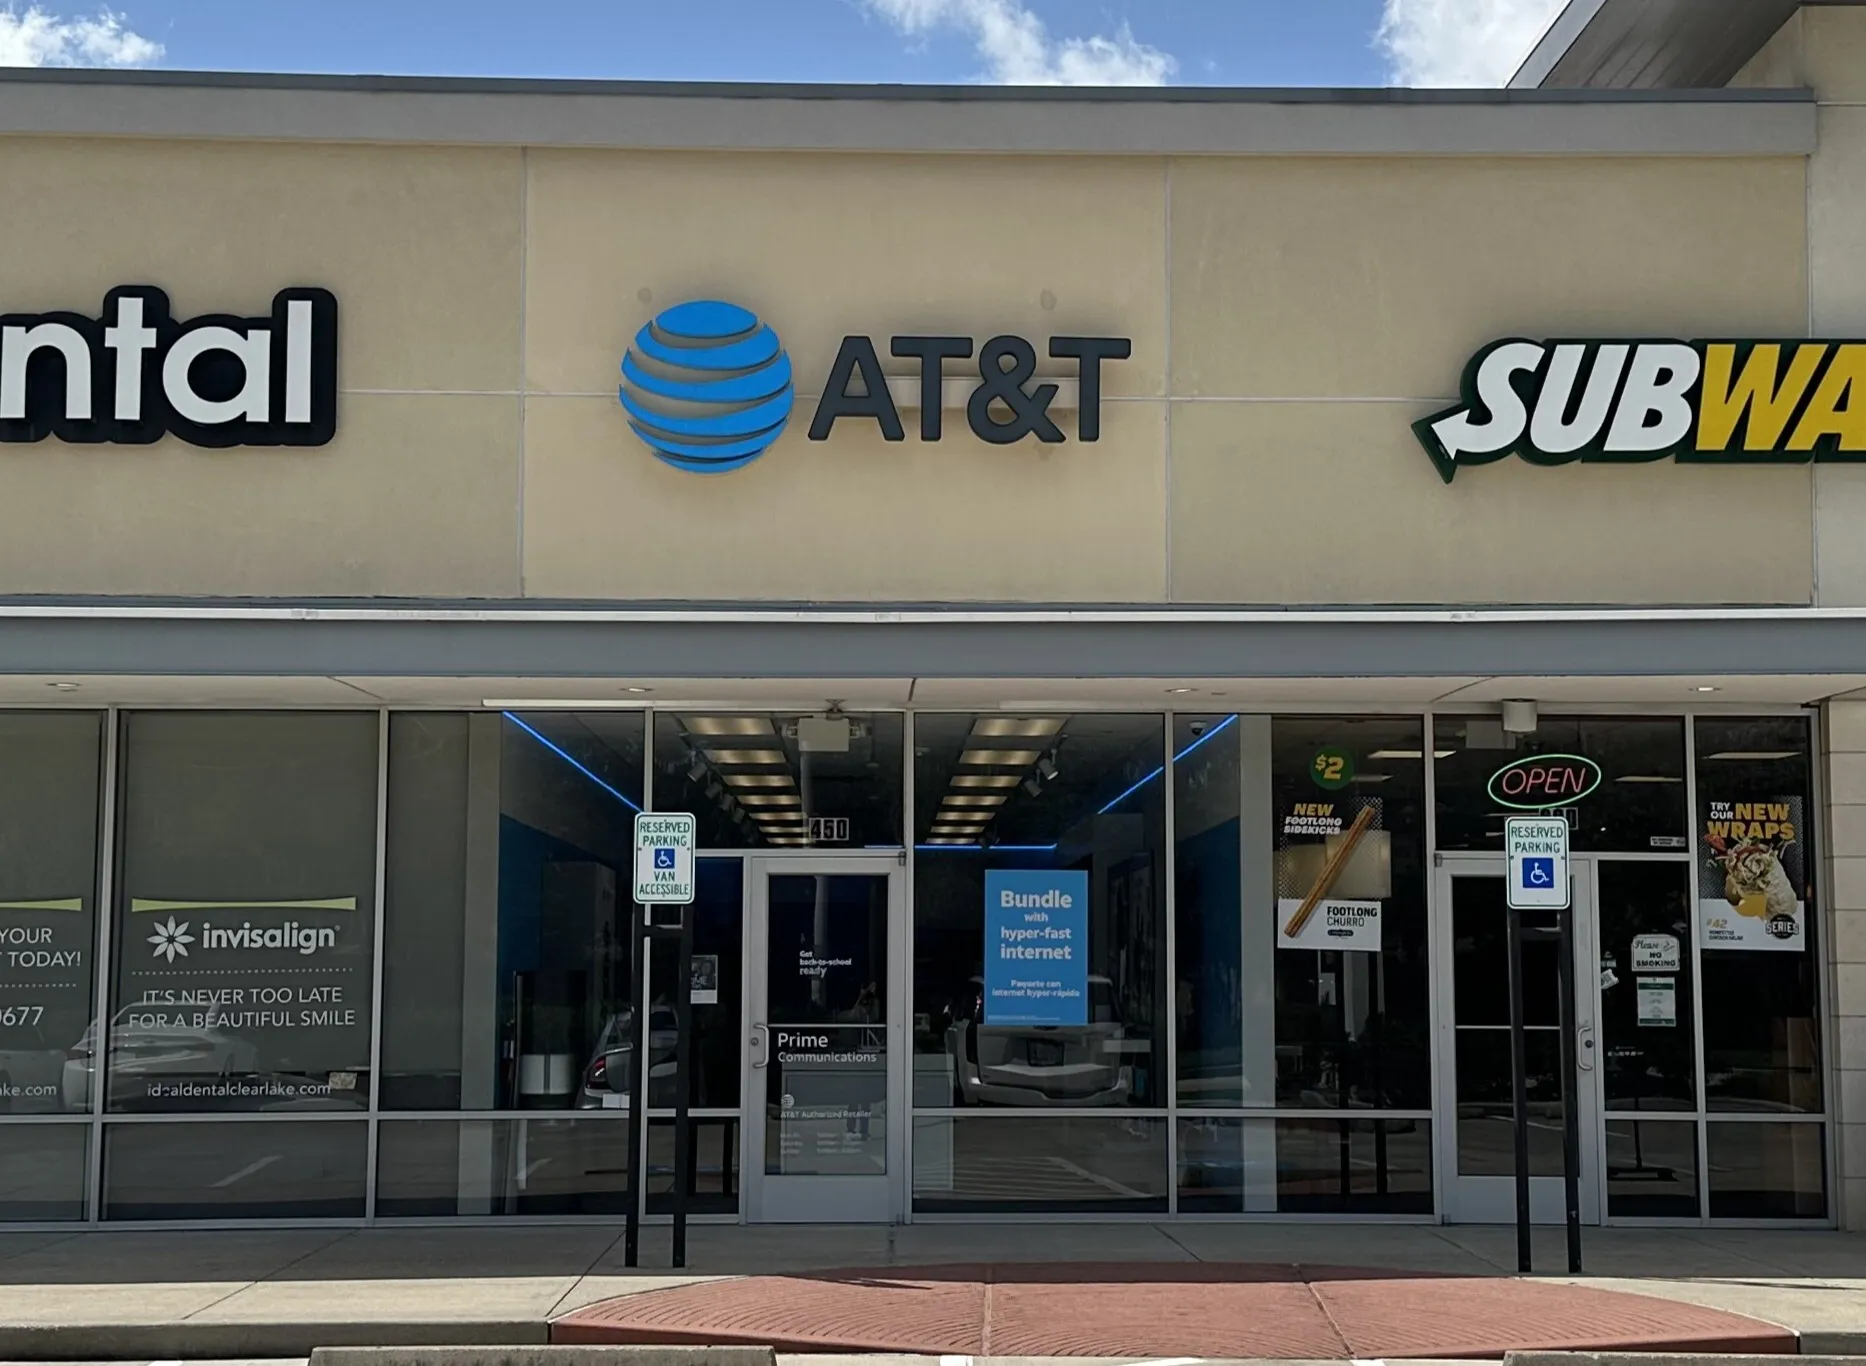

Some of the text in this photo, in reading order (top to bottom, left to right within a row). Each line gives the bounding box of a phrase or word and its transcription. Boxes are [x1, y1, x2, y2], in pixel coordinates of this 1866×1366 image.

[0, 297, 313, 424] ntal
[807, 335, 1132, 445] AT&T
[1431, 342, 1866, 460] SUBWA
[1314, 754, 1344, 781] $2
[1502, 767, 1586, 796] OPEN
[1293, 803, 1335, 817] NEW
[1710, 802, 1731, 811] TRY
[1735, 802, 1790, 821] NEW
[1285, 817, 1342, 827] FOOTLONG
[1710, 811, 1734, 820] OUR
[639, 821, 690, 834] RESERVED
[810, 820, 847, 840] 450
[1283, 825, 1341, 835] SIDEKICKS
[1511, 826, 1564, 839] RESERVED
[1706, 821, 1796, 840] WRAPS
[642, 835, 687, 847] PARKING
[1515, 841, 1560, 853] PARKING
[654, 871, 676, 882] VAN
[639, 883, 690, 895] ACCESSIBLE
[1000, 889, 1073, 908] Bundle
[1024, 912, 1049, 922] with
[1327, 906, 1378, 917] FOOTLONG
[1327, 916, 1365, 927] CHURRO
[1765, 921, 1800, 936] SERIES
[0, 927, 53, 944] YOUR
[1000, 926, 1072, 941] hyper-fast
[1000, 943, 1072, 960] internet
[1649, 951, 1662, 959] NO
[8, 951, 82, 968] TODAY!
[1636, 959, 1676, 967] SMOKING
[799, 966, 828, 979] ready
[143, 987, 343, 1006] IT'S NEVER TOO LATE
[0, 1006, 45, 1026] 677
[128, 1009, 356, 1029] FOR A BEAUTIFUL SMILE
[777, 1032, 829, 1049] Prime
[777, 1051, 878, 1063] Communications
[147, 1080, 331, 1097] idealdentalclearlake.com
